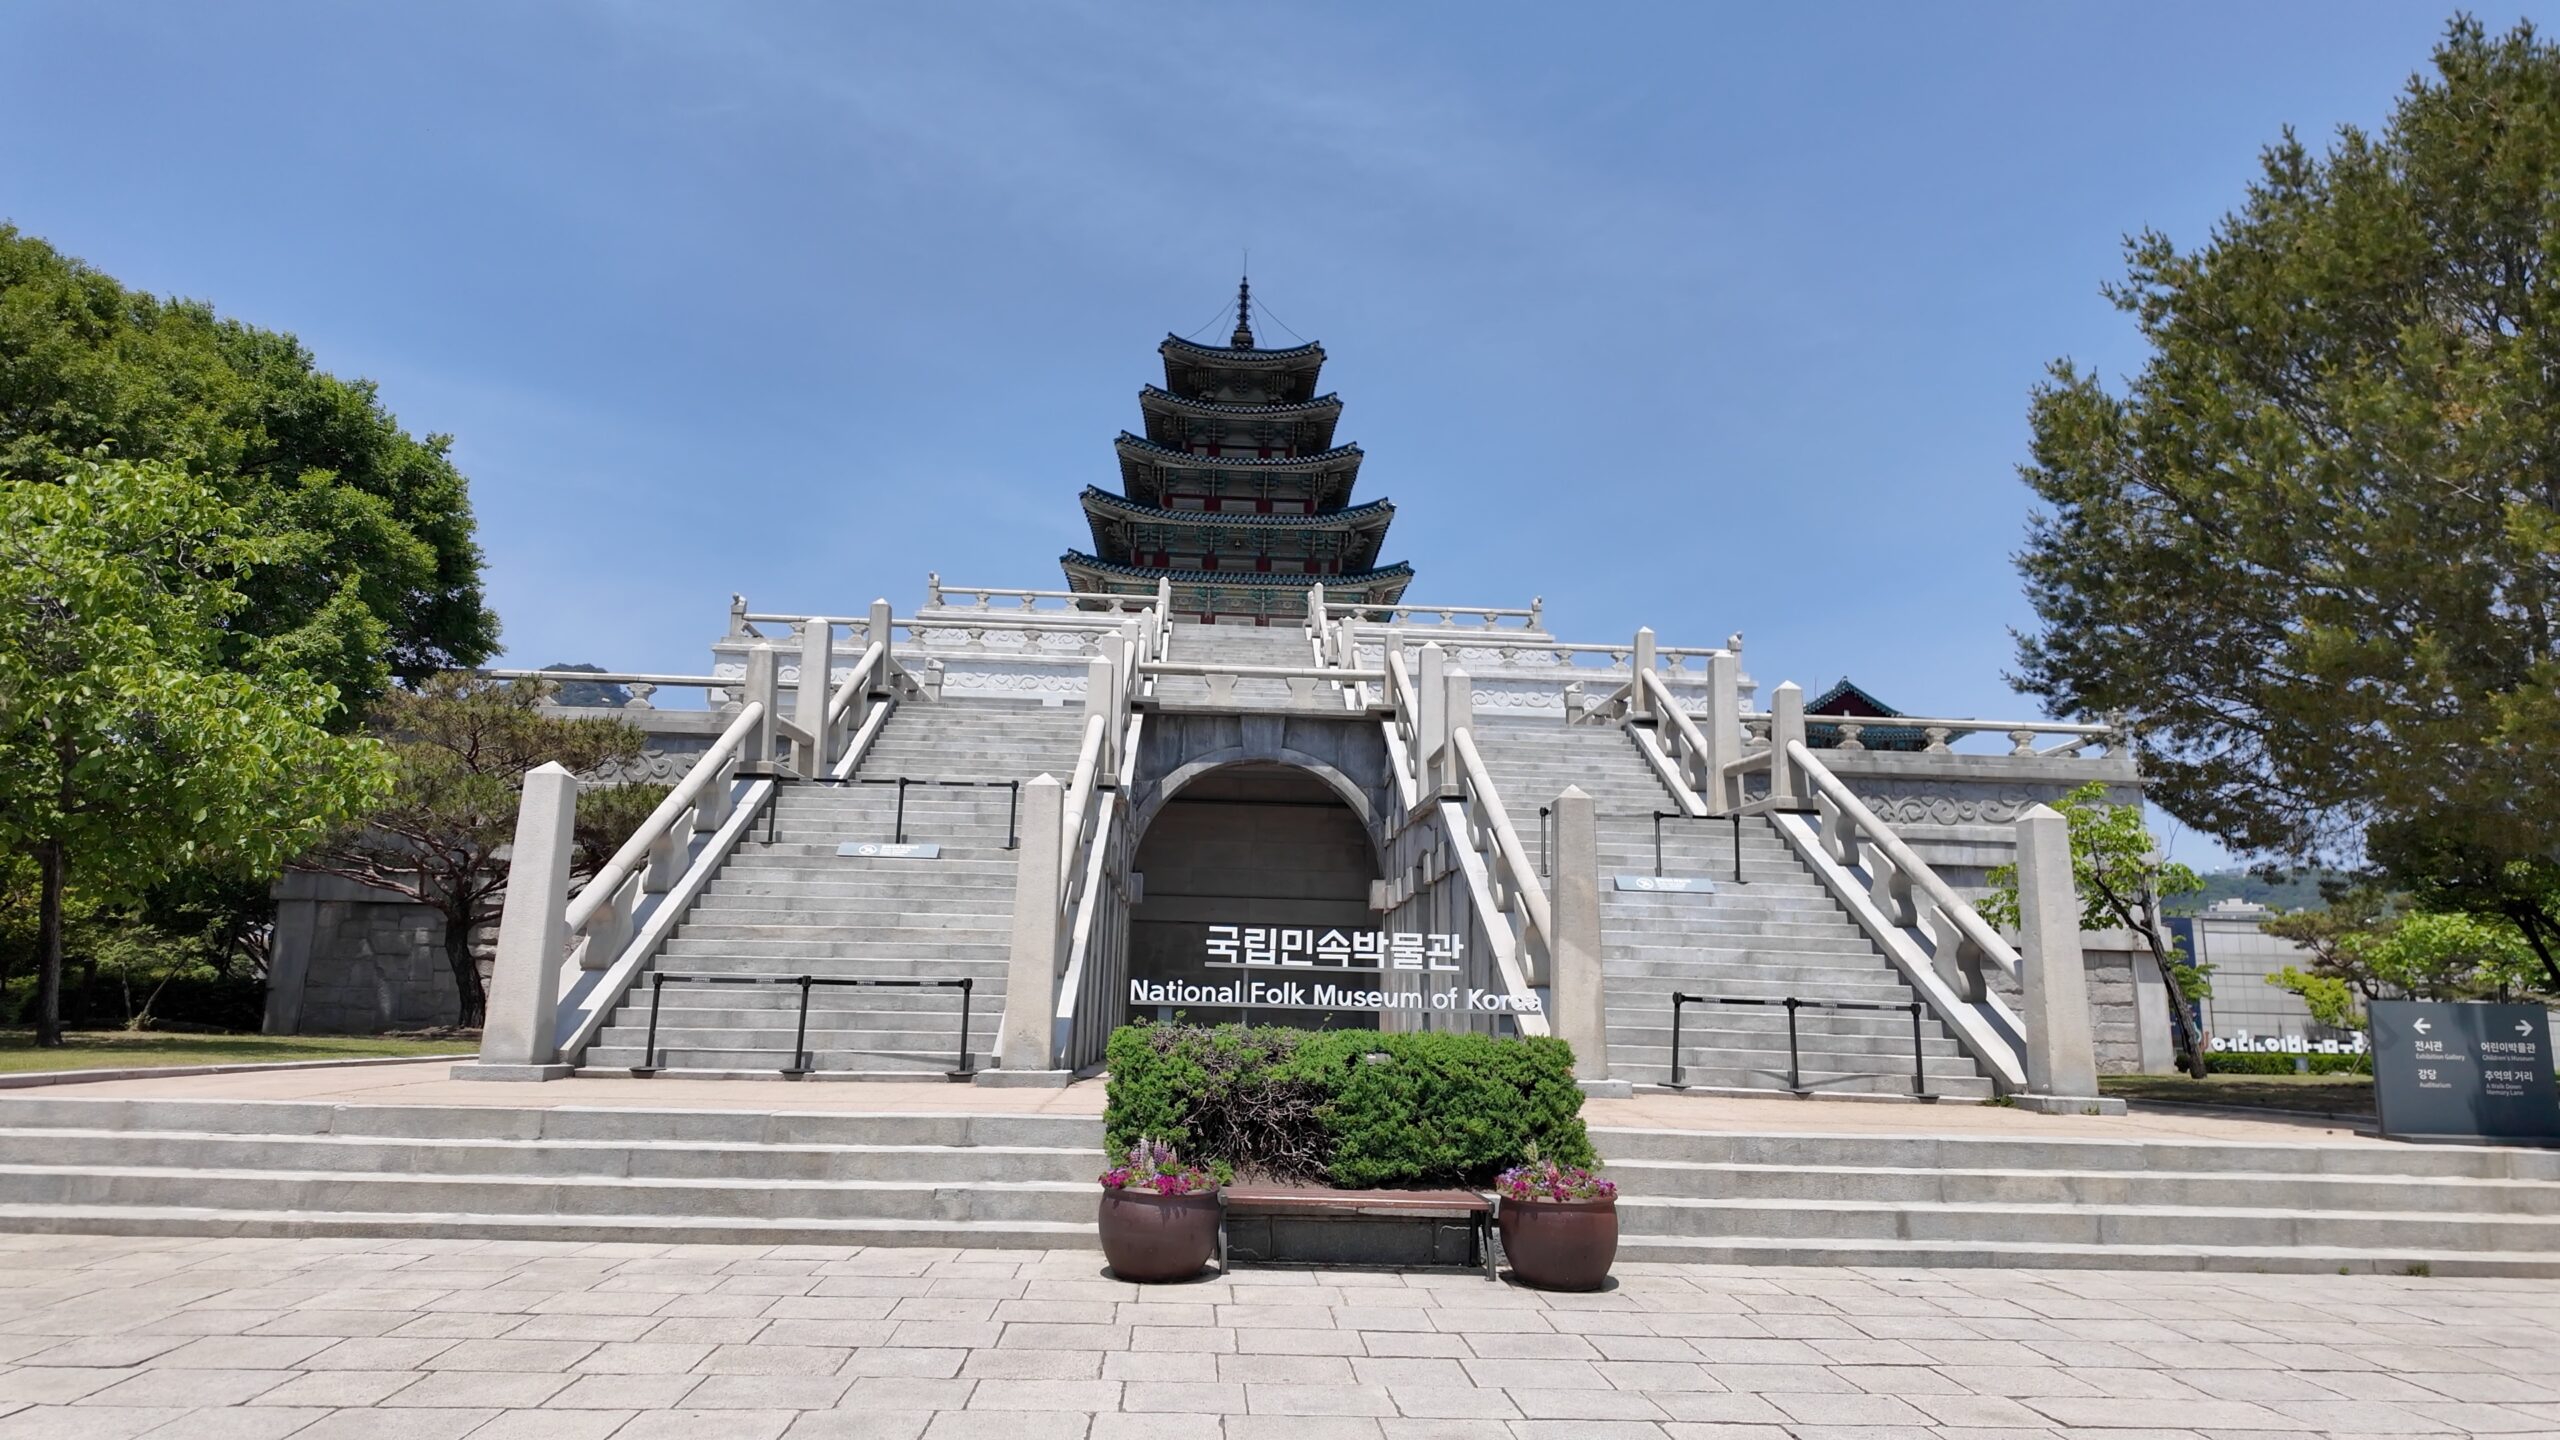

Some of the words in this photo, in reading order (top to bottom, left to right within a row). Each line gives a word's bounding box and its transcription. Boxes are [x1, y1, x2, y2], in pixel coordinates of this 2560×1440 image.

[1205, 924, 1465, 971] 국립민속박물관
[1129, 979, 1241, 1004] National
[1250, 982, 1306, 1006] Folk
[1313, 984, 1422, 1009] Museum
[1431, 986, 1458, 1010] of
[1467, 988, 1542, 1012] Korea
[2414, 1040, 2443, 1052] 전시관
[2480, 1042, 2536, 1054] 어린이박물관
[2445, 1054, 2465, 1062] Gallery
[2417, 1069, 2437, 1080] 강당
[2484, 1070, 2512, 1081] 추억의
[2514, 1071, 2533, 1082] 거리
